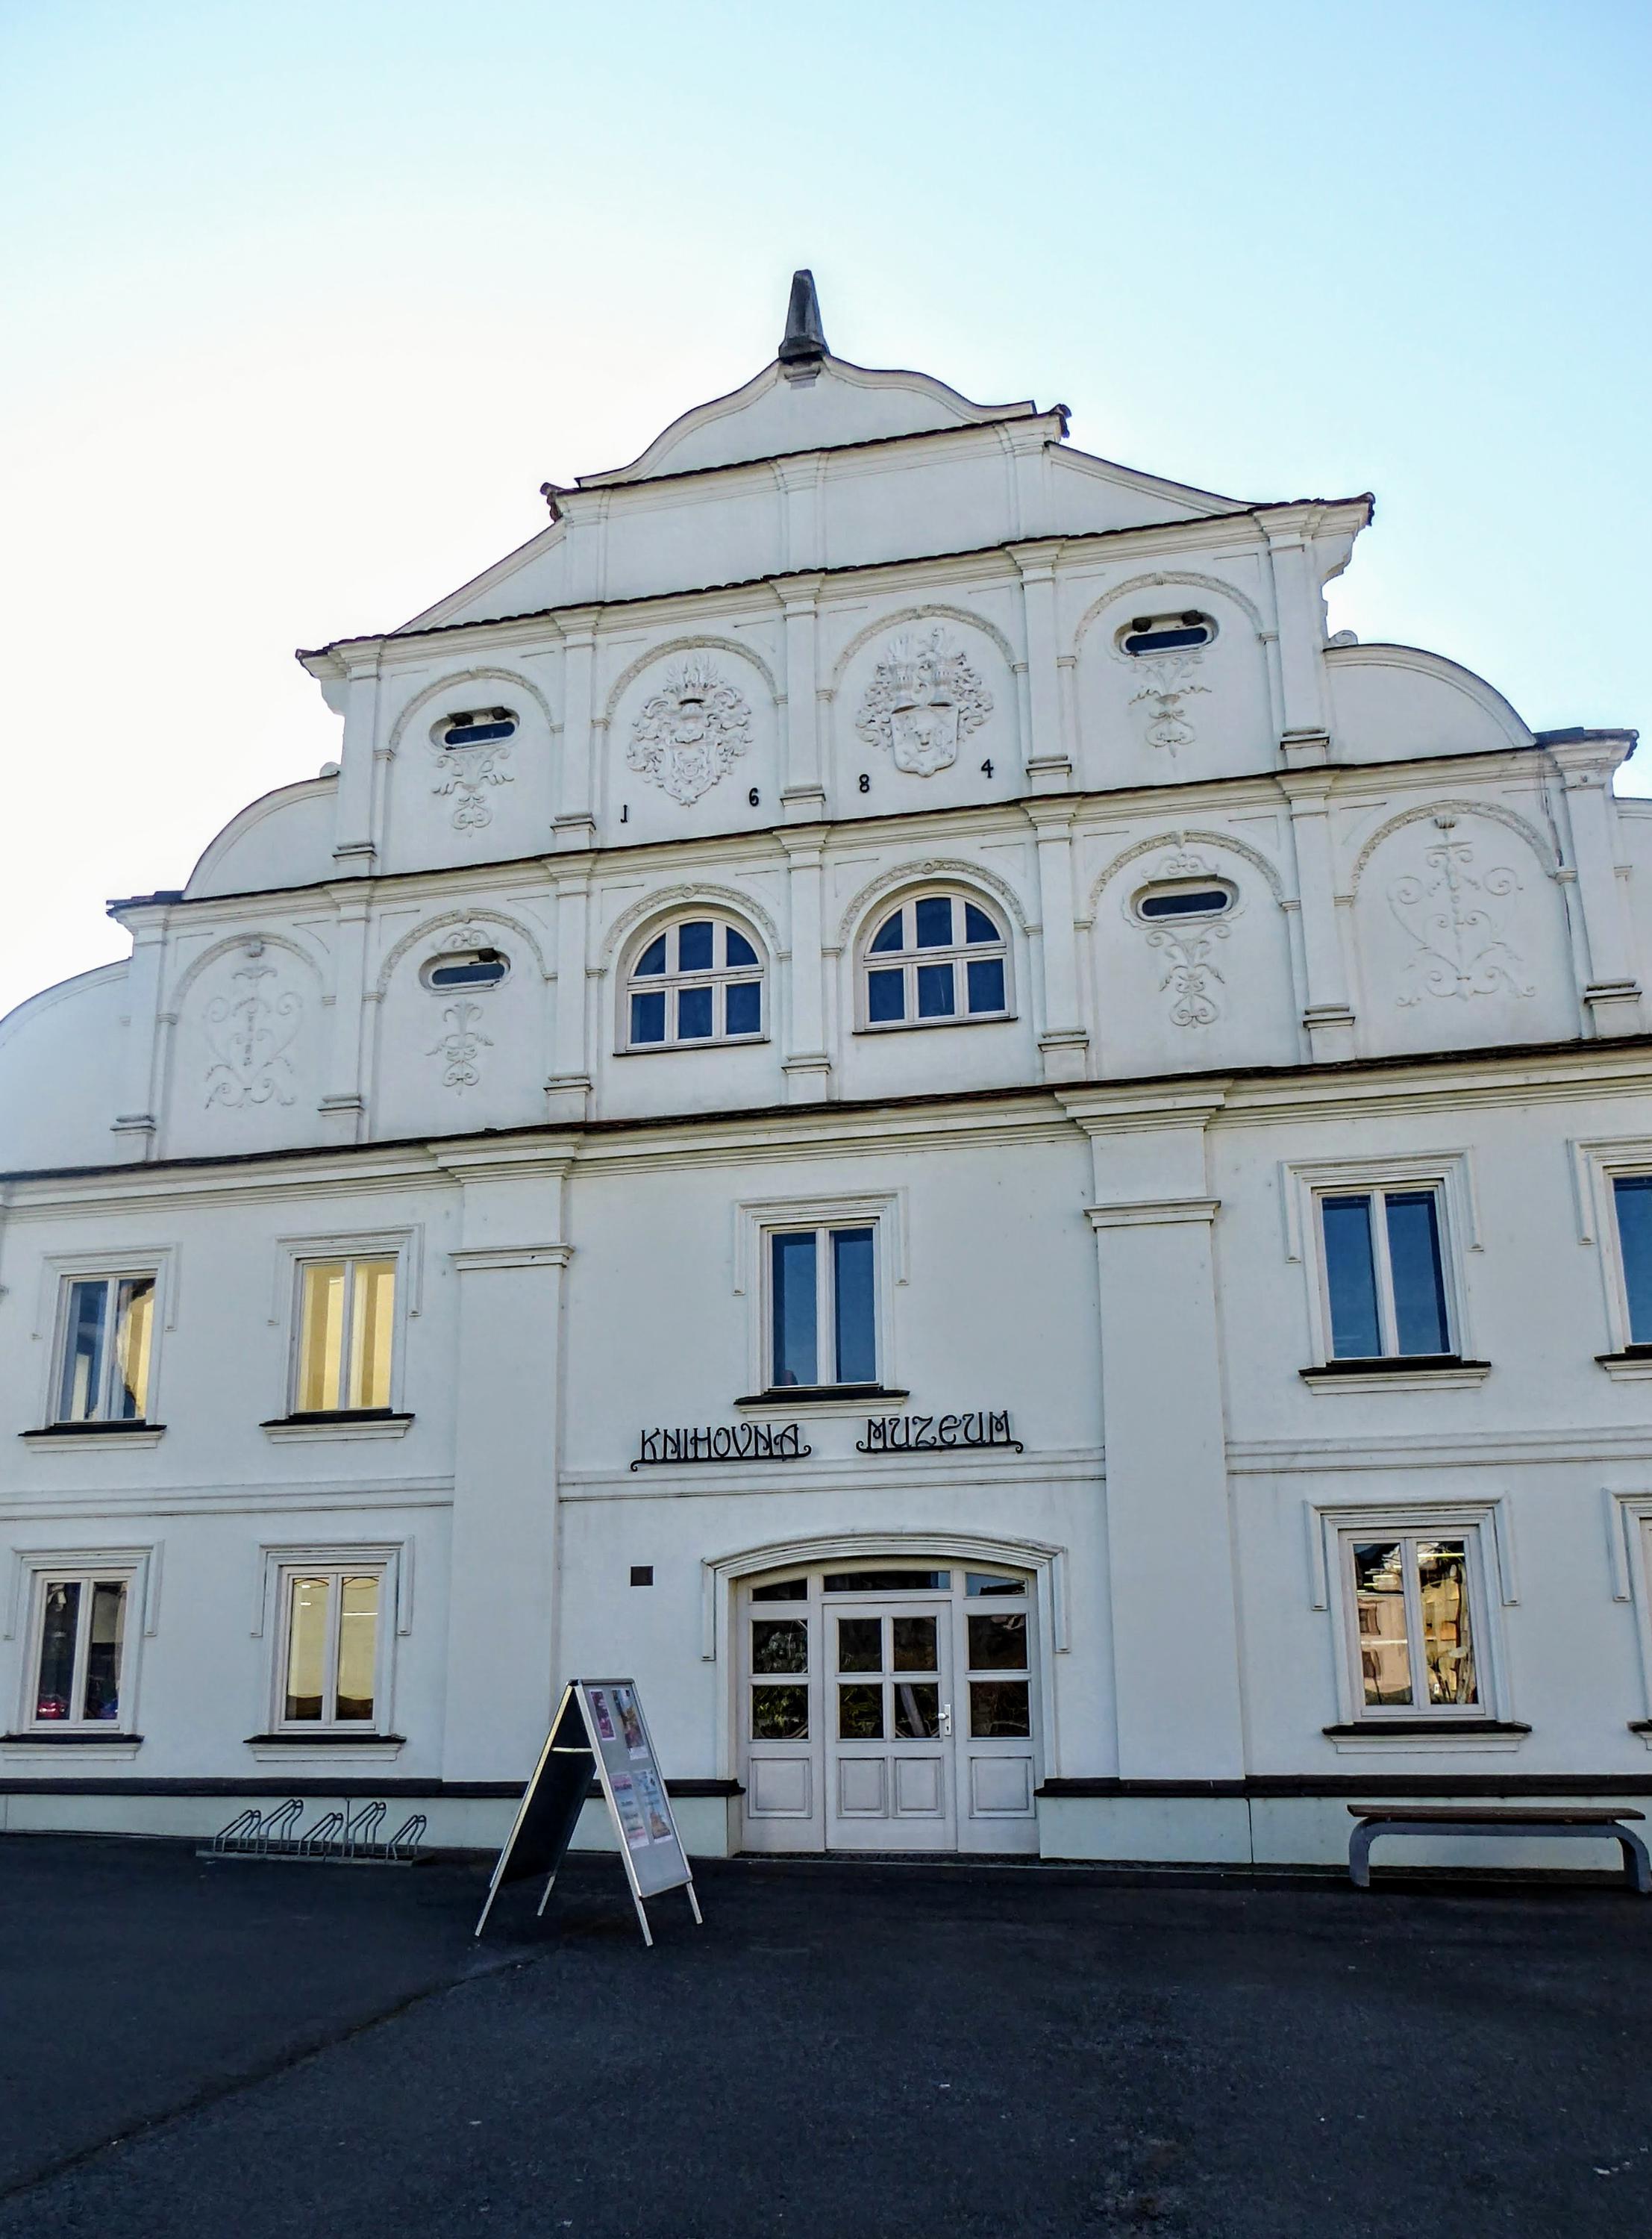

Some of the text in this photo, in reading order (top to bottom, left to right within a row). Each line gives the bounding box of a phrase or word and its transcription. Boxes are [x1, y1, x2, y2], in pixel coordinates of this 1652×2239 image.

[748, 787, 760, 807] 6
[859, 774, 870, 793] 8
[980, 758, 995, 778] 4
[639, 1410, 1013, 1463] KNIHOVNA MUZEUM
